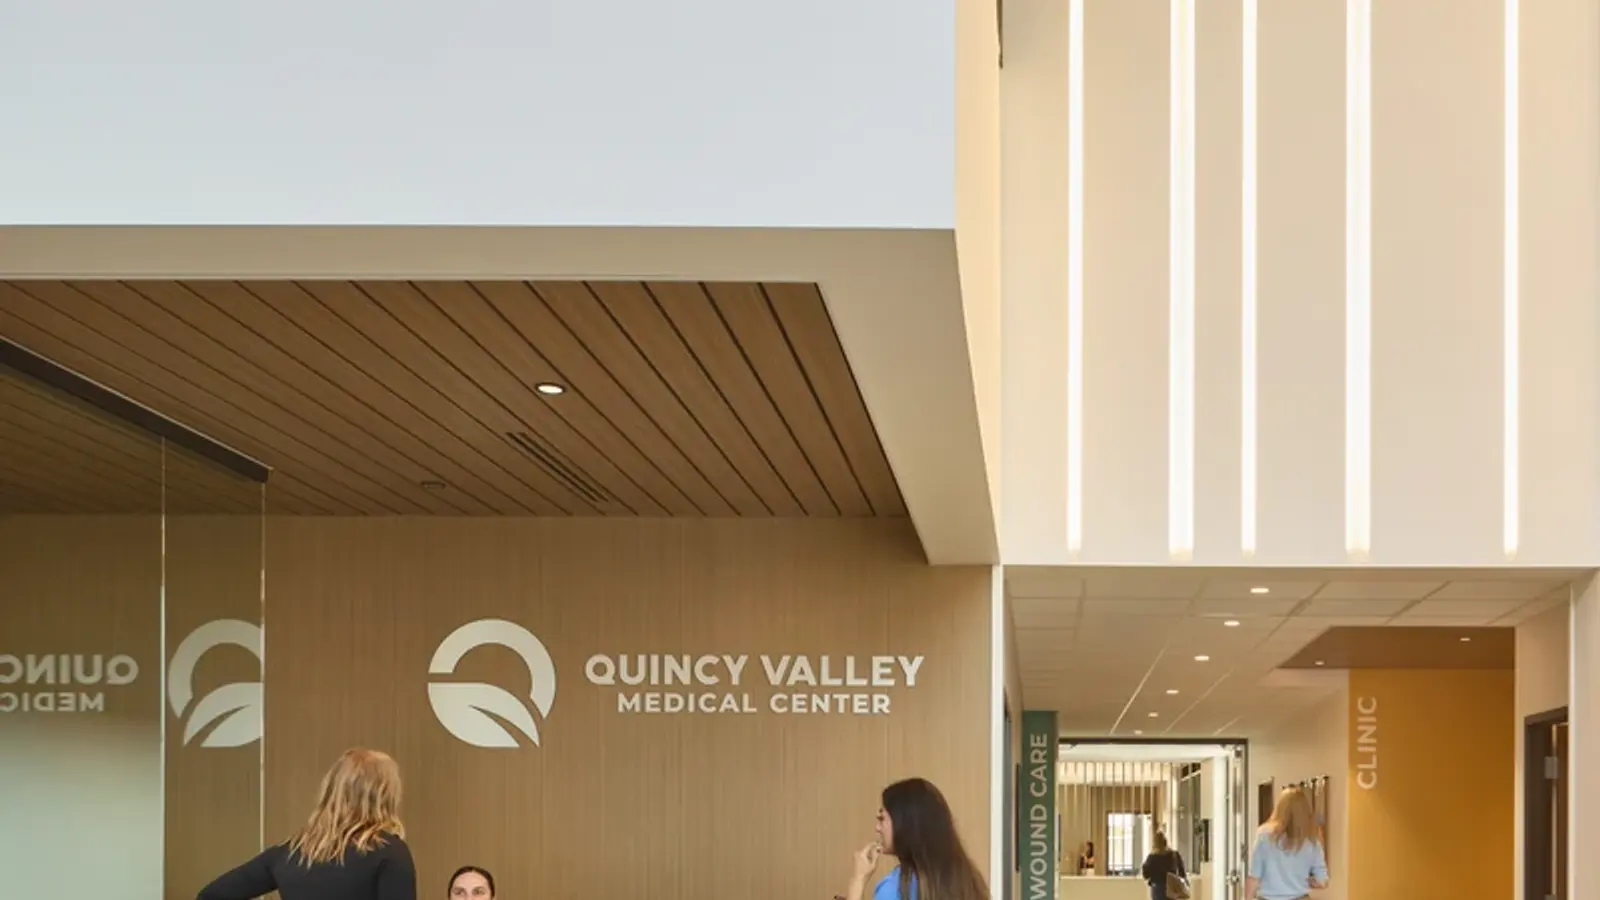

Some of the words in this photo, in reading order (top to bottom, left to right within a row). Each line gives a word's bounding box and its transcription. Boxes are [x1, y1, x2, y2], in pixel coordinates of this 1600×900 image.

[585, 654, 748, 686] QUINCY
[760, 655, 924, 687] VALLEY
[617, 692, 757, 714] MEDICAL
[770, 693, 891, 714] CENTER
[1030, 733, 1048, 797] CARE
[1357, 696, 1377, 789] CLINIC
[1030, 804, 1048, 900] WOUND
